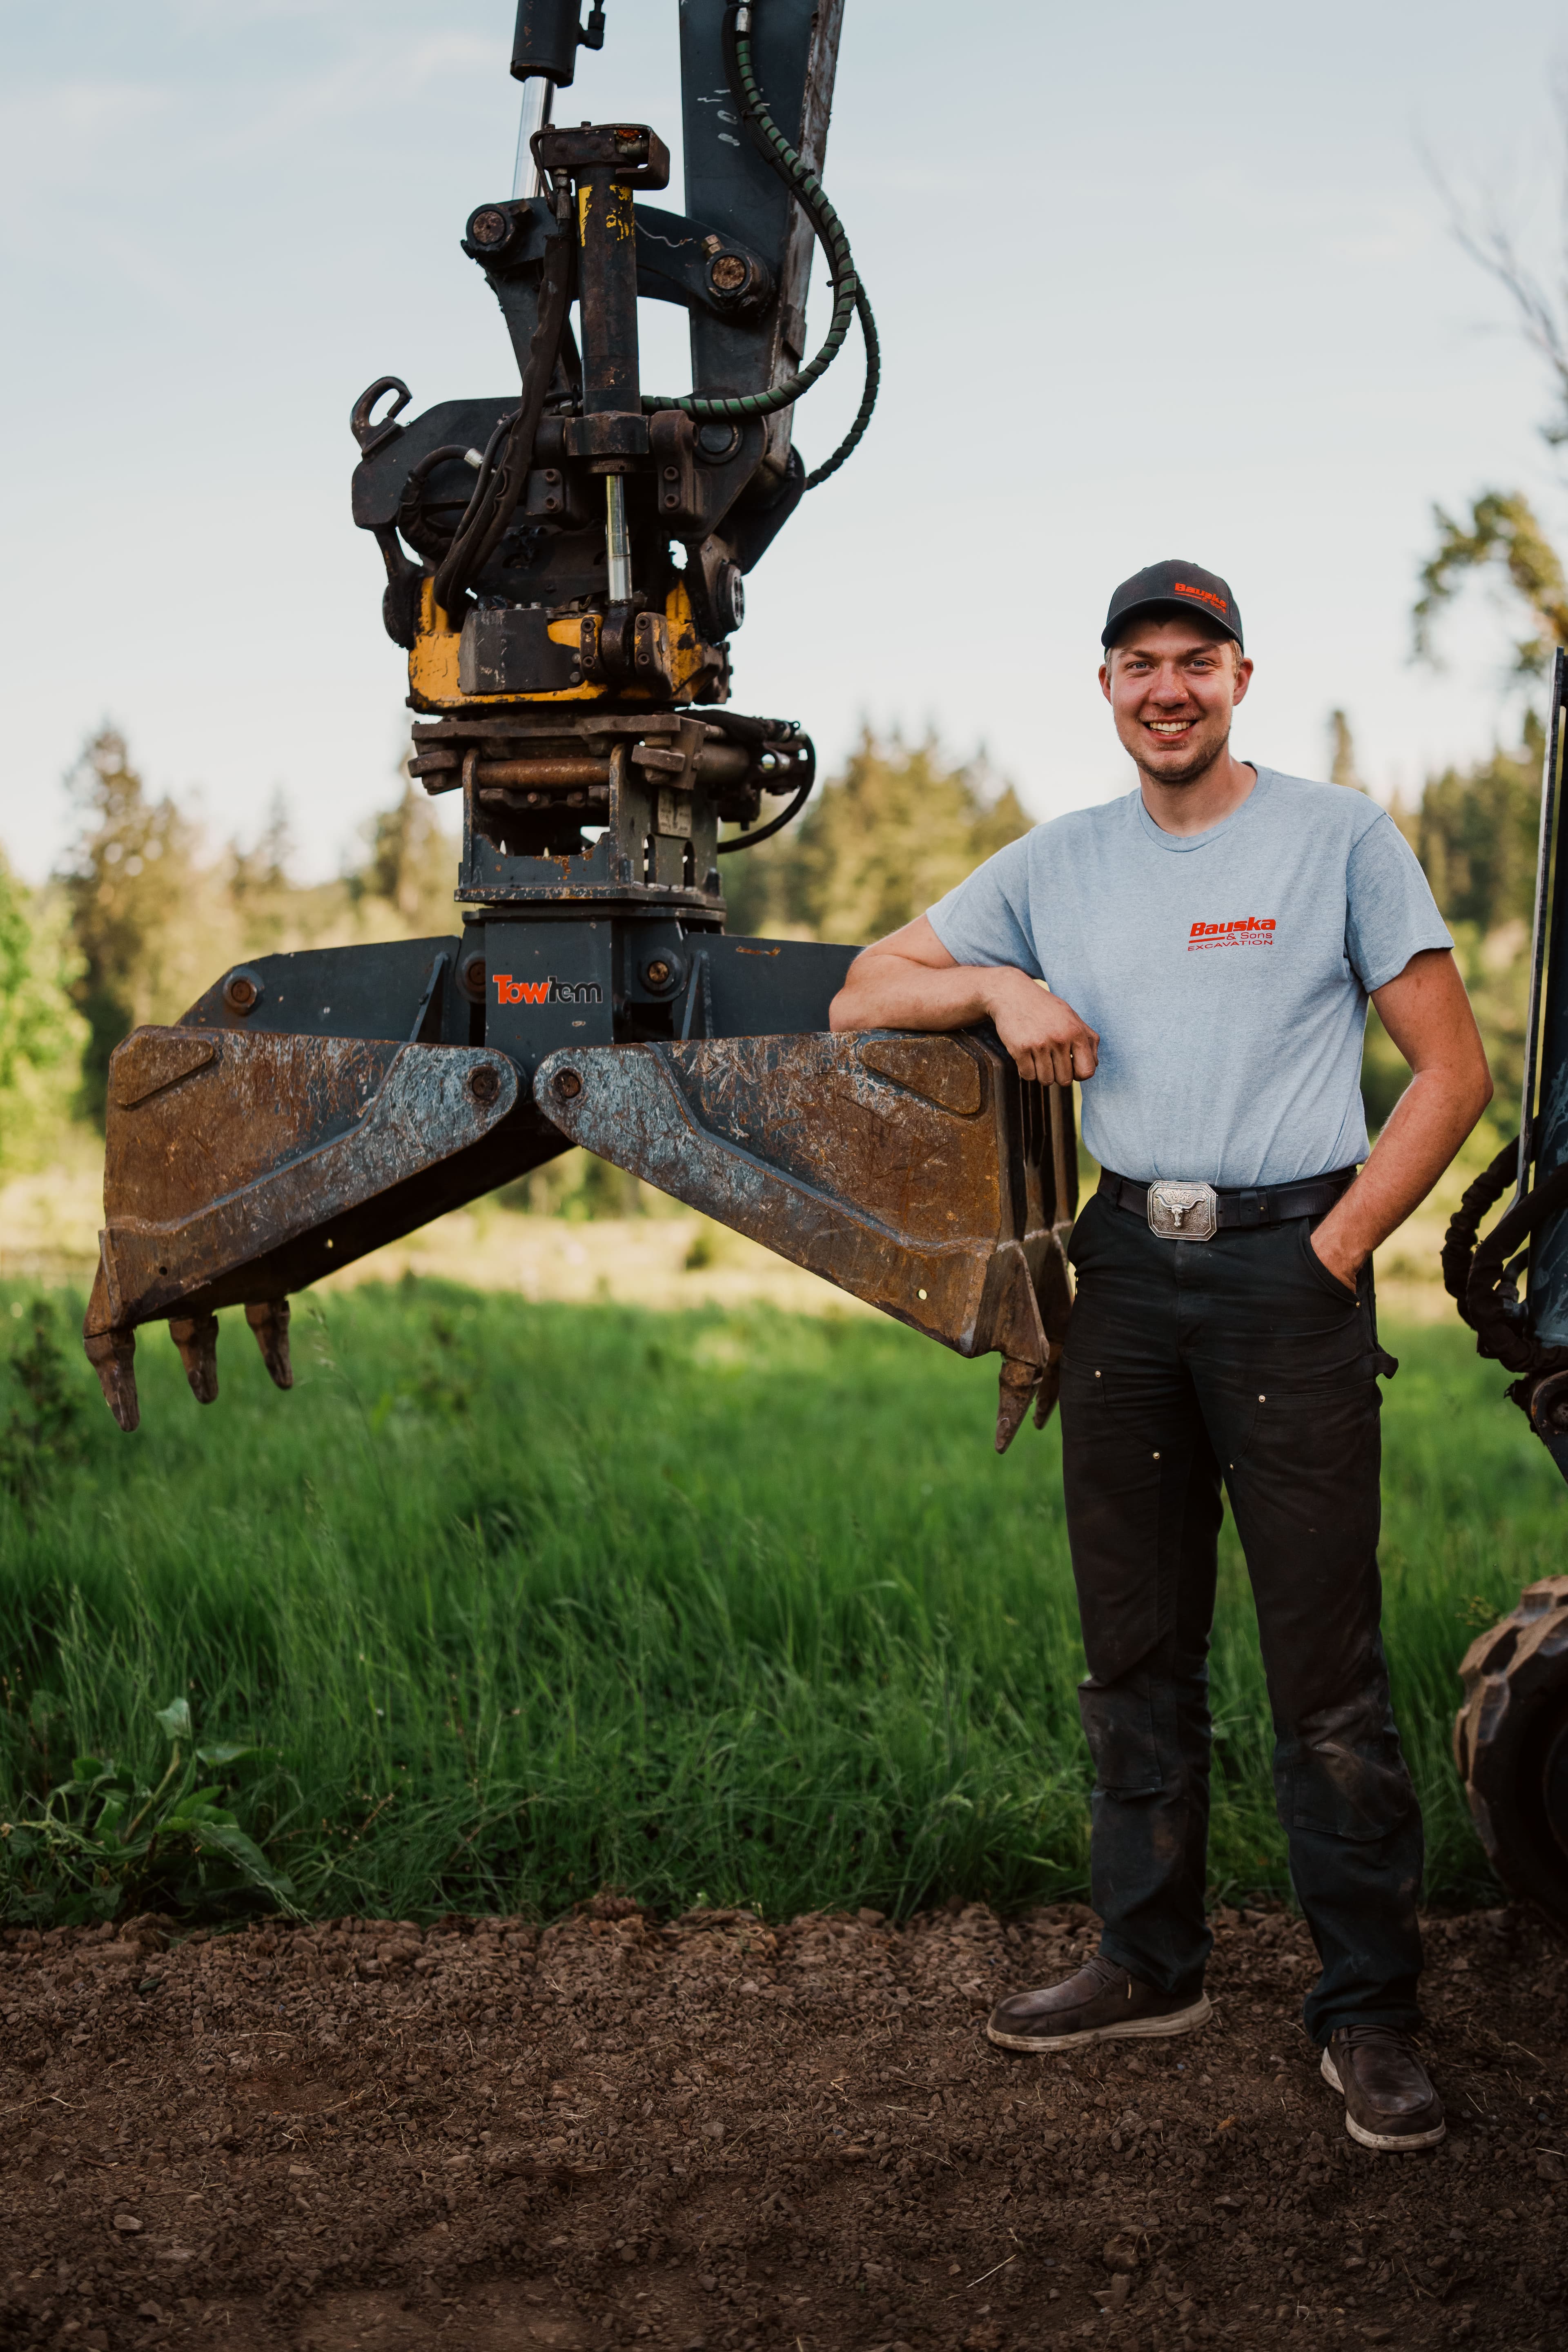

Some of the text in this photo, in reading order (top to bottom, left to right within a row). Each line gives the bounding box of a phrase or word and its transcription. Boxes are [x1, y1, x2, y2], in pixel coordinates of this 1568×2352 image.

[1175, 583, 1227, 608] Bauska
[1210, 600, 1226, 613] Sons
[1190, 917, 1276, 937] Bauska
[1188, 940, 1273, 951] EXCAVATION
